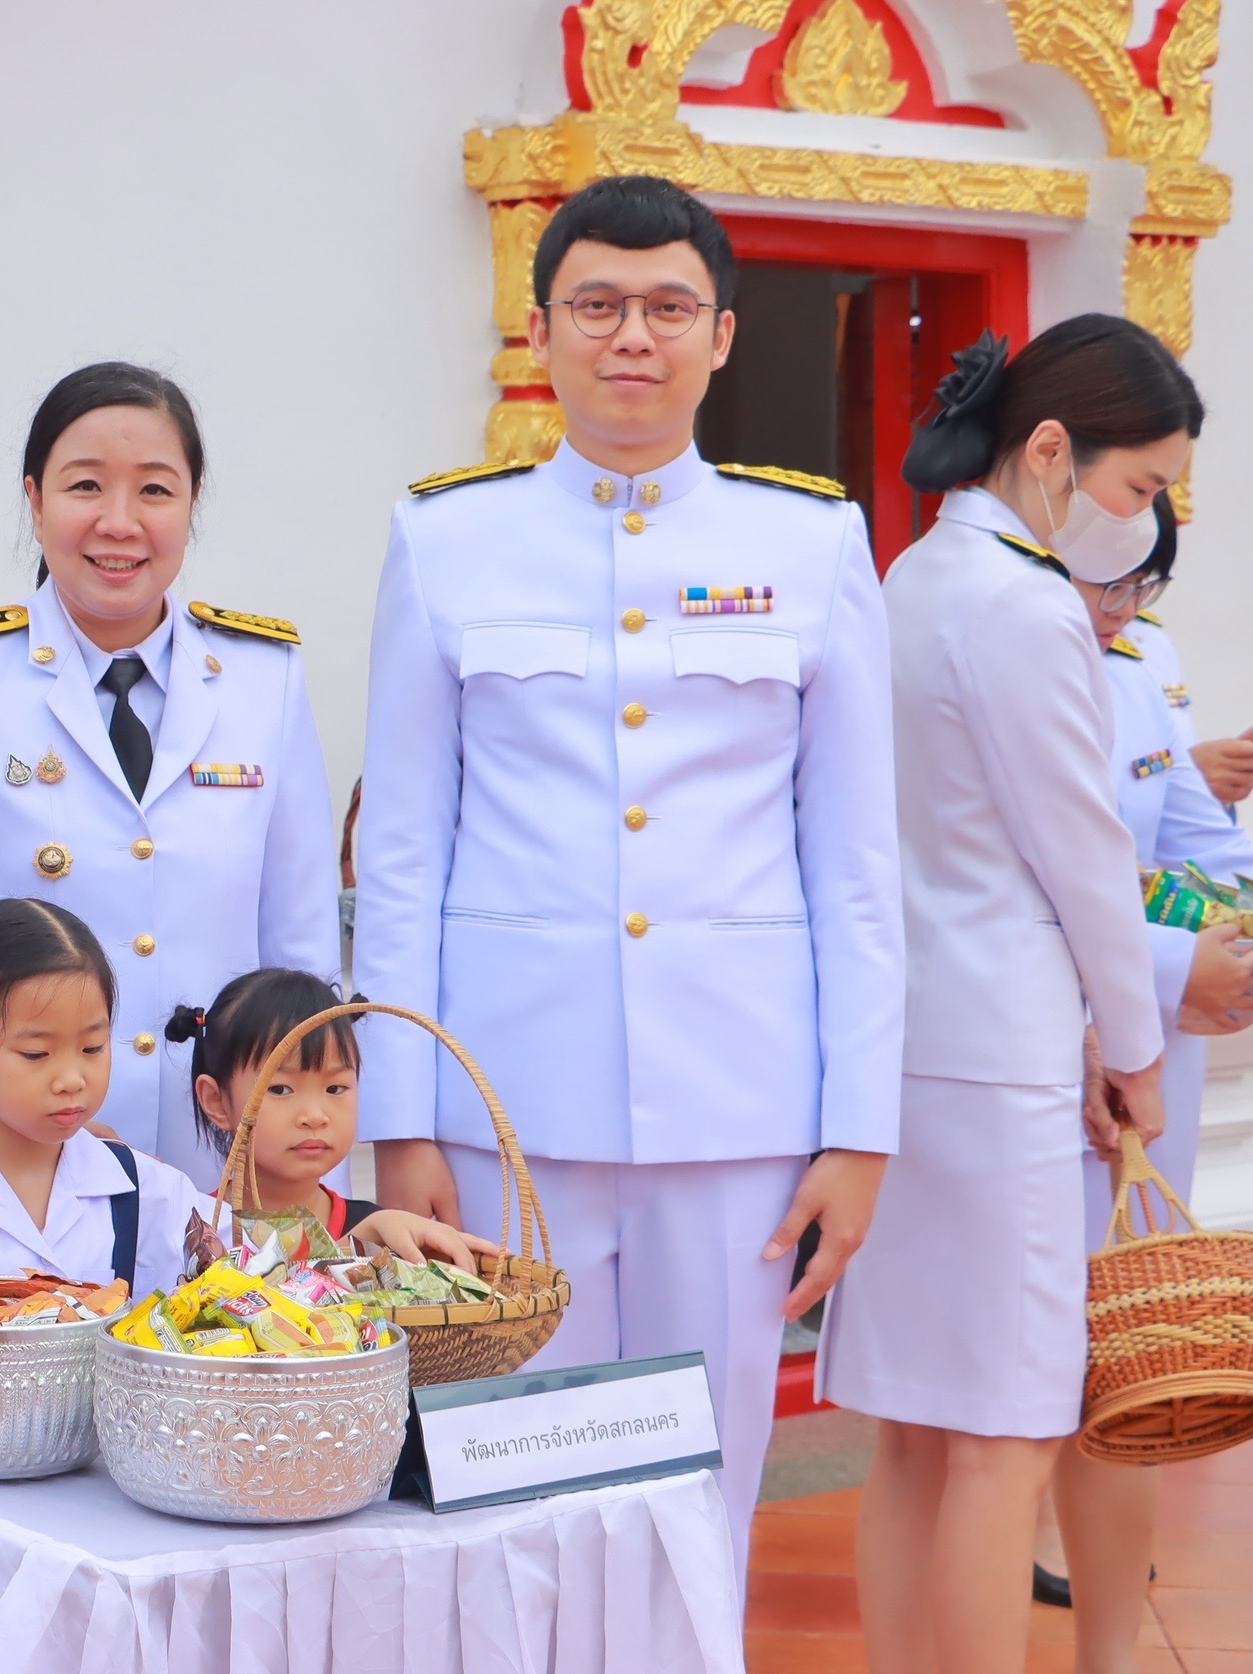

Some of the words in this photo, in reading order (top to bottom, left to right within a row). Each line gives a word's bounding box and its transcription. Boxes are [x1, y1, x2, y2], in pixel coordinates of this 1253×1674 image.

[462, 1411, 679, 1462] พัฒนาการจังหวัดสกลนคร
